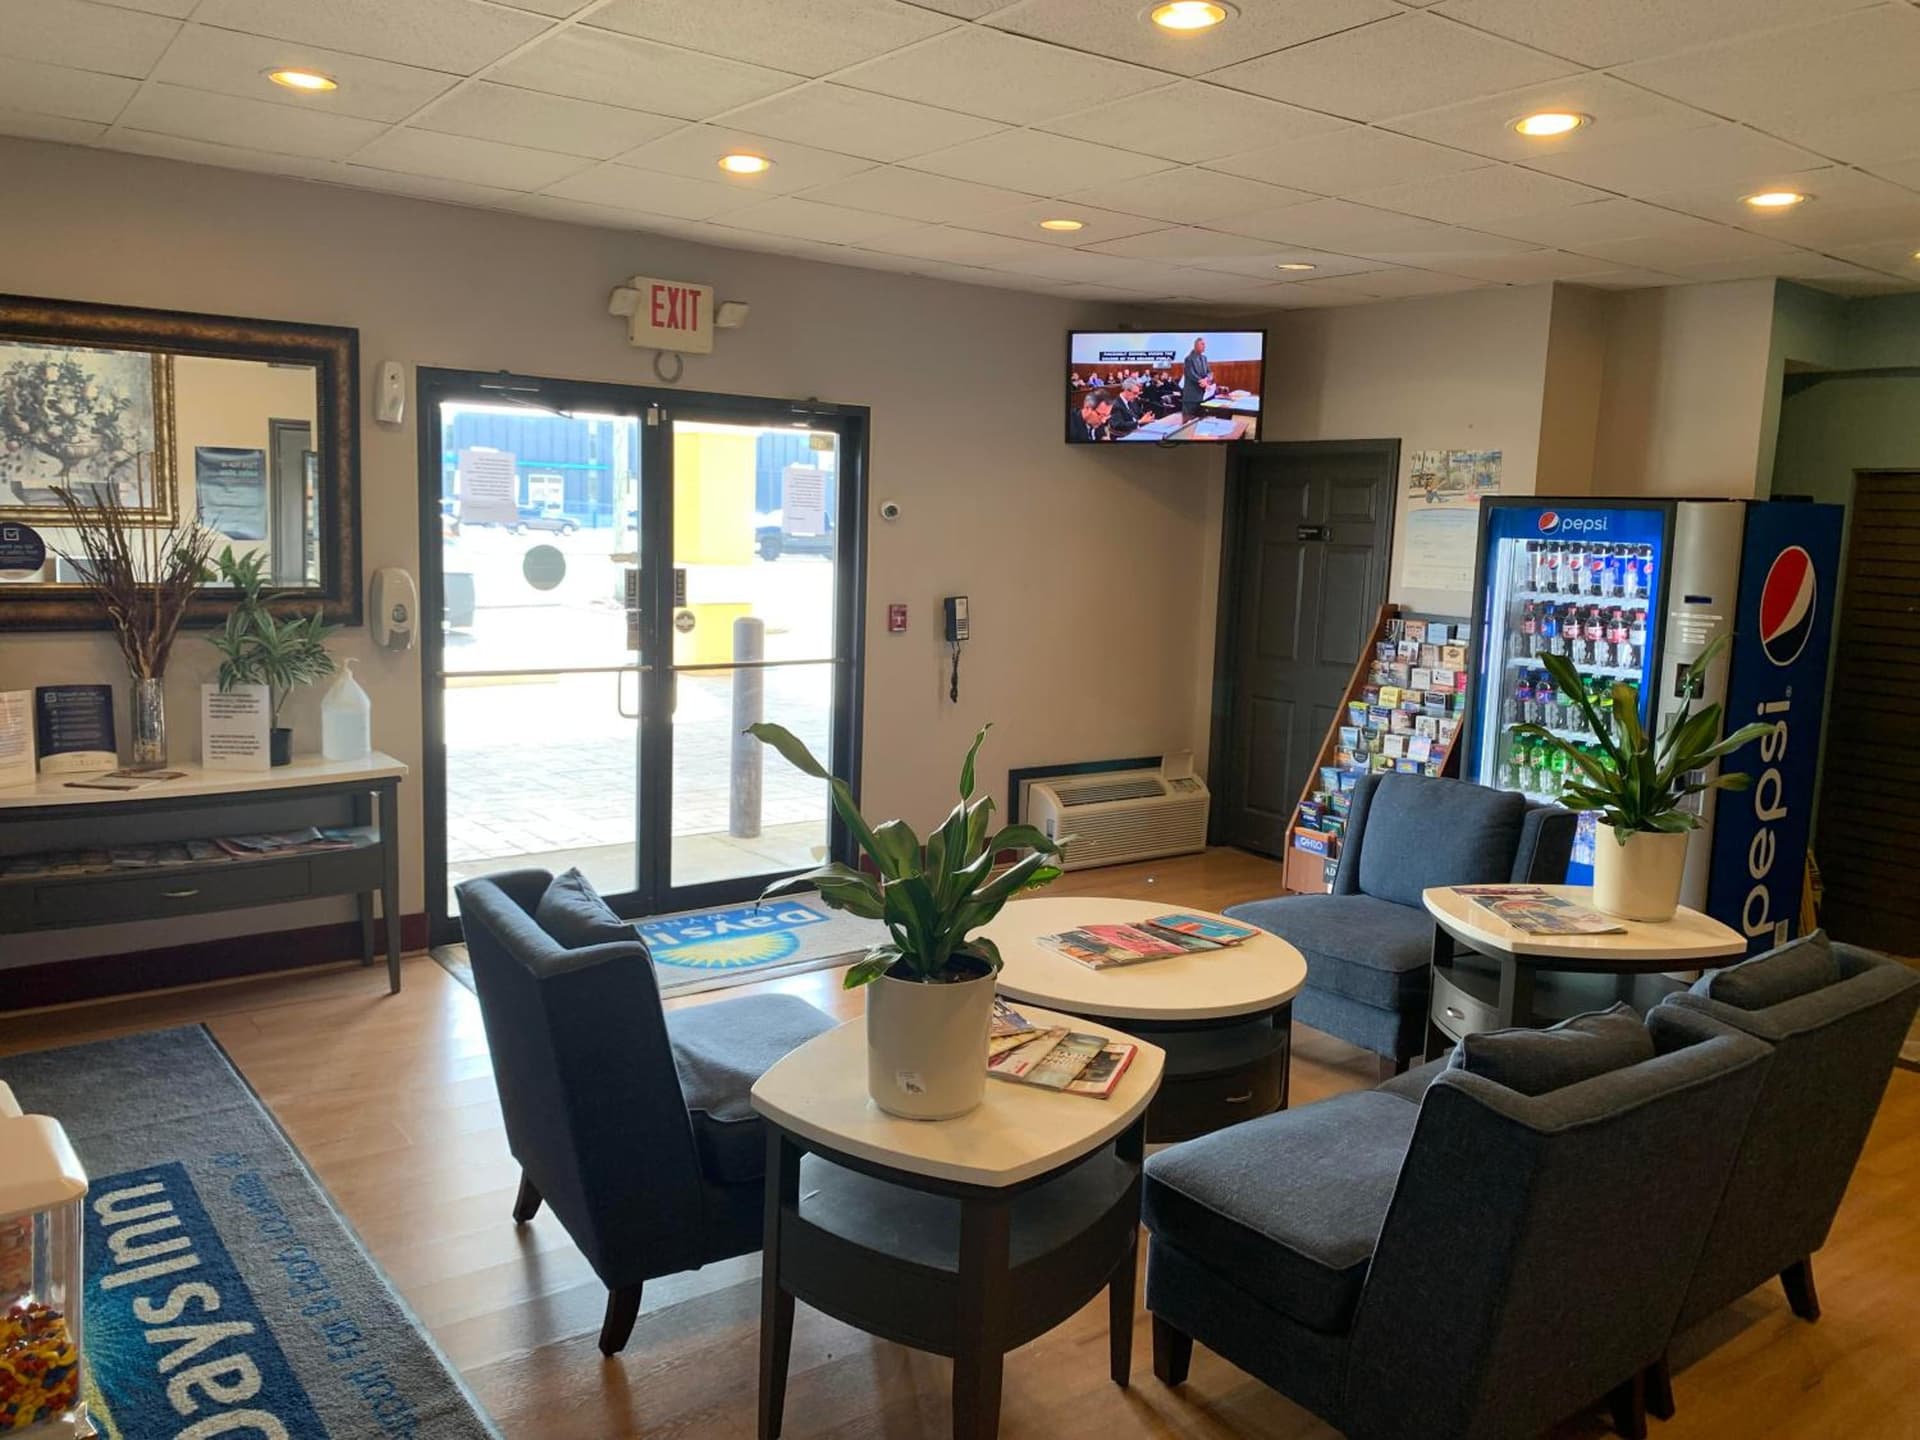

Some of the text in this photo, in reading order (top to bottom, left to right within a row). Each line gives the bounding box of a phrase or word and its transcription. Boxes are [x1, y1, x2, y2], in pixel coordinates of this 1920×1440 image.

[651, 285, 702, 331] EXIT
[1561, 516, 1608, 533] pepsi
[1742, 700, 1792, 938] pepsi
[643, 913, 730, 931] WYND
[680, 909, 822, 939] Days
[92, 1182, 201, 1291] Inn
